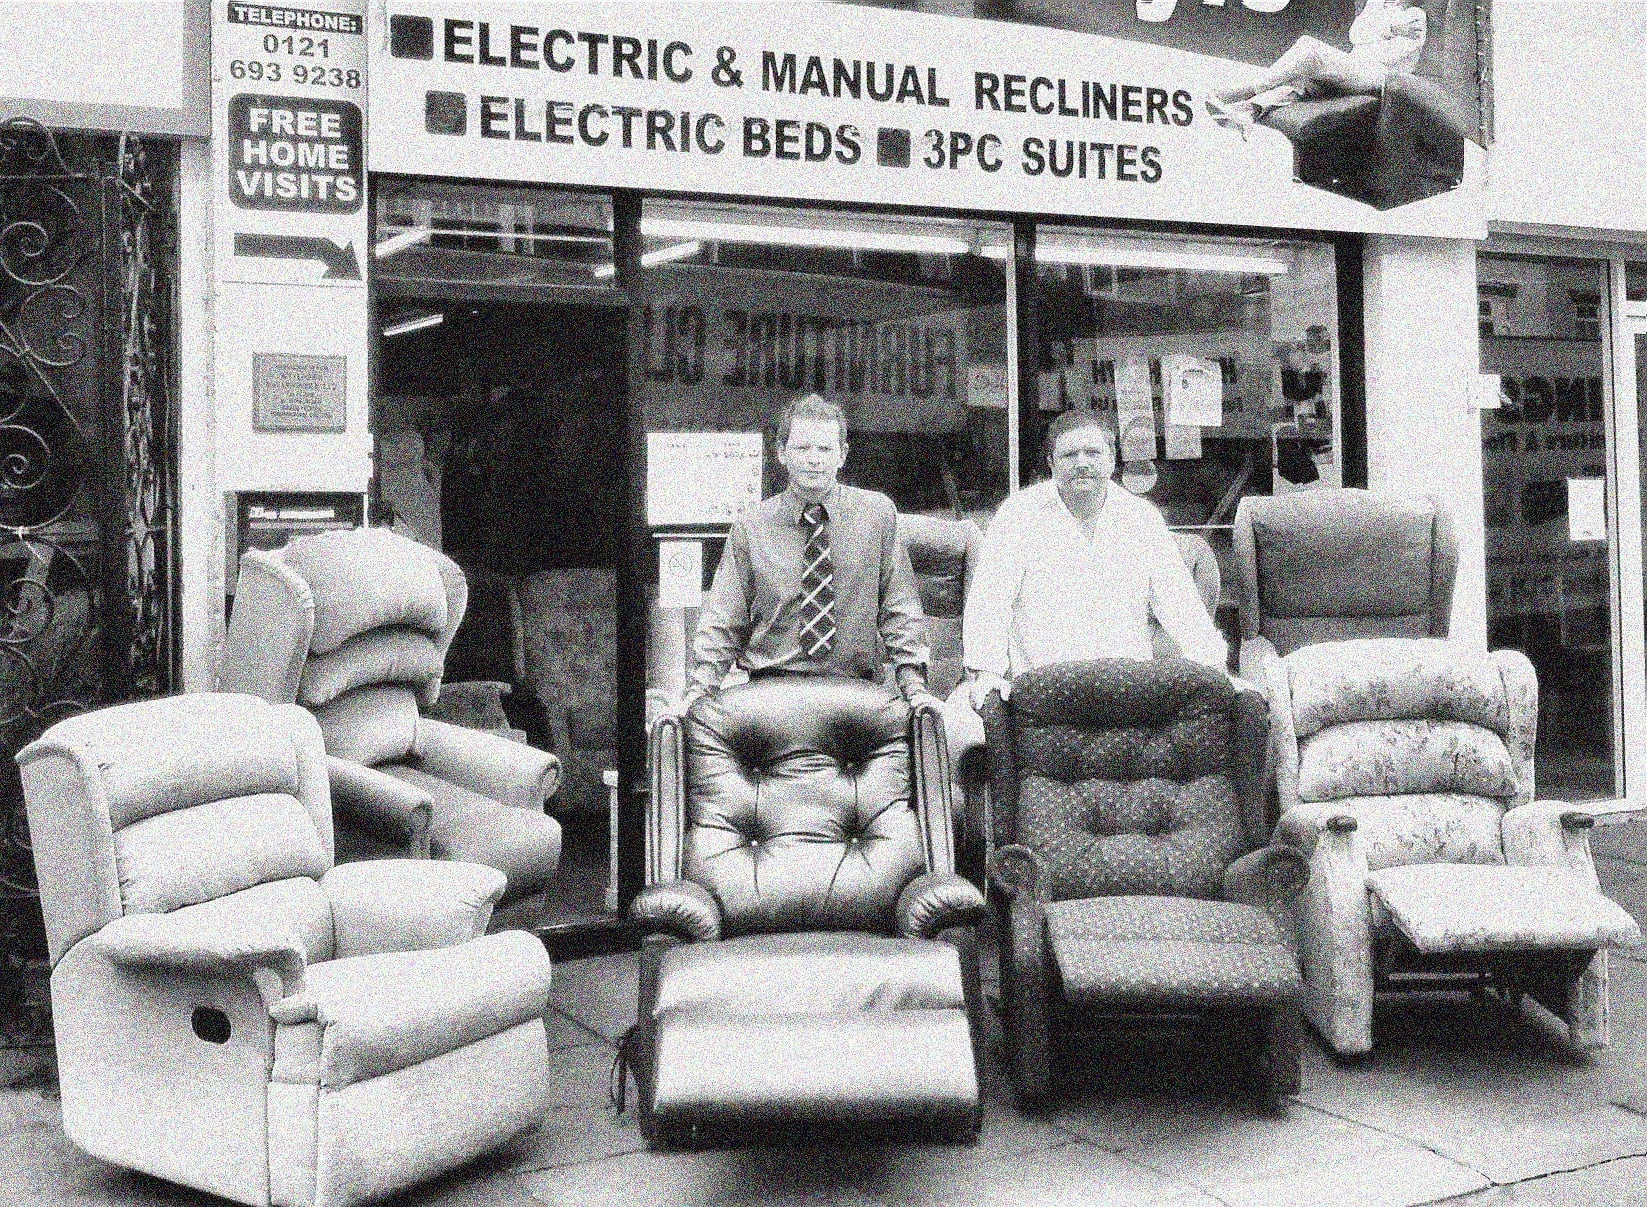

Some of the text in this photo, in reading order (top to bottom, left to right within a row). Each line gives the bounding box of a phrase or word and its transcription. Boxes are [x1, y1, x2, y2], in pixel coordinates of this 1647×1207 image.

[233, 7, 357, 31] TELEPHONE:
[263, 34, 329, 58] 0121
[230, 60, 361, 89] 693 9238
[444, 19, 1193, 126] ELECTRIC & MANUAL RECLINERS
[250, 108, 341, 138] FREE
[481, 96, 1162, 183] ELECTRIC BEDS 3PC SUITES
[243, 140, 348, 169] HOME
[237, 170, 356, 201] VISITS
